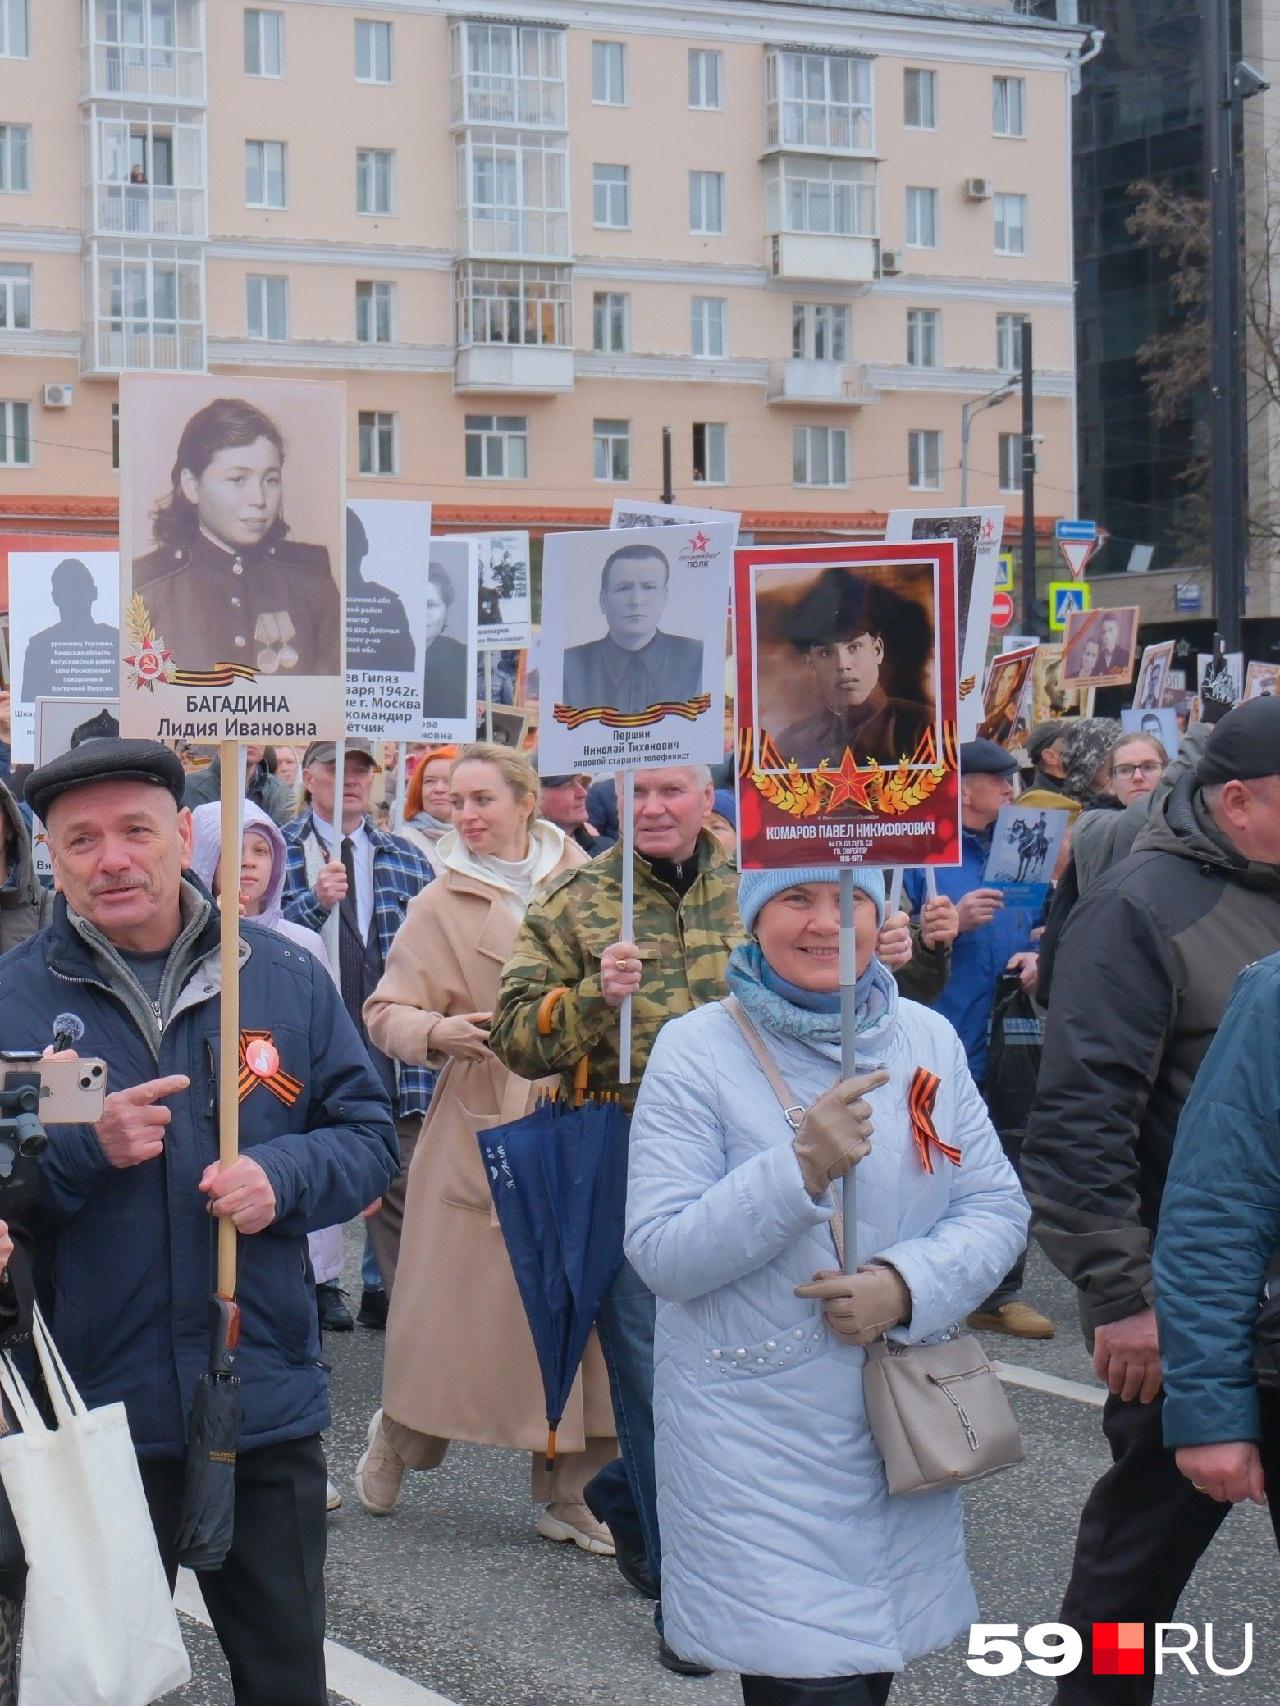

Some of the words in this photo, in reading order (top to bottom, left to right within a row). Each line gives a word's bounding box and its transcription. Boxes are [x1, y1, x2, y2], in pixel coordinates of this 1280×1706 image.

[362, 672, 400, 684] Гиляз
[186, 695, 290, 715] БАГАДИНА
[372, 697, 422, 709] Москва
[346, 710, 413, 723] командир
[157, 718, 218, 738] Лидия
[225, 718, 318, 737] Ивановна
[613, 730, 650, 741] Першин
[583, 742, 625, 756] Николай
[628, 740, 680, 753] Тихонович
[766, 825, 816, 841] КОМАРОВ
[819, 824, 854, 839] ПАВЕЛ
[856, 821, 936, 838] НИКИФОРОВИЧ
